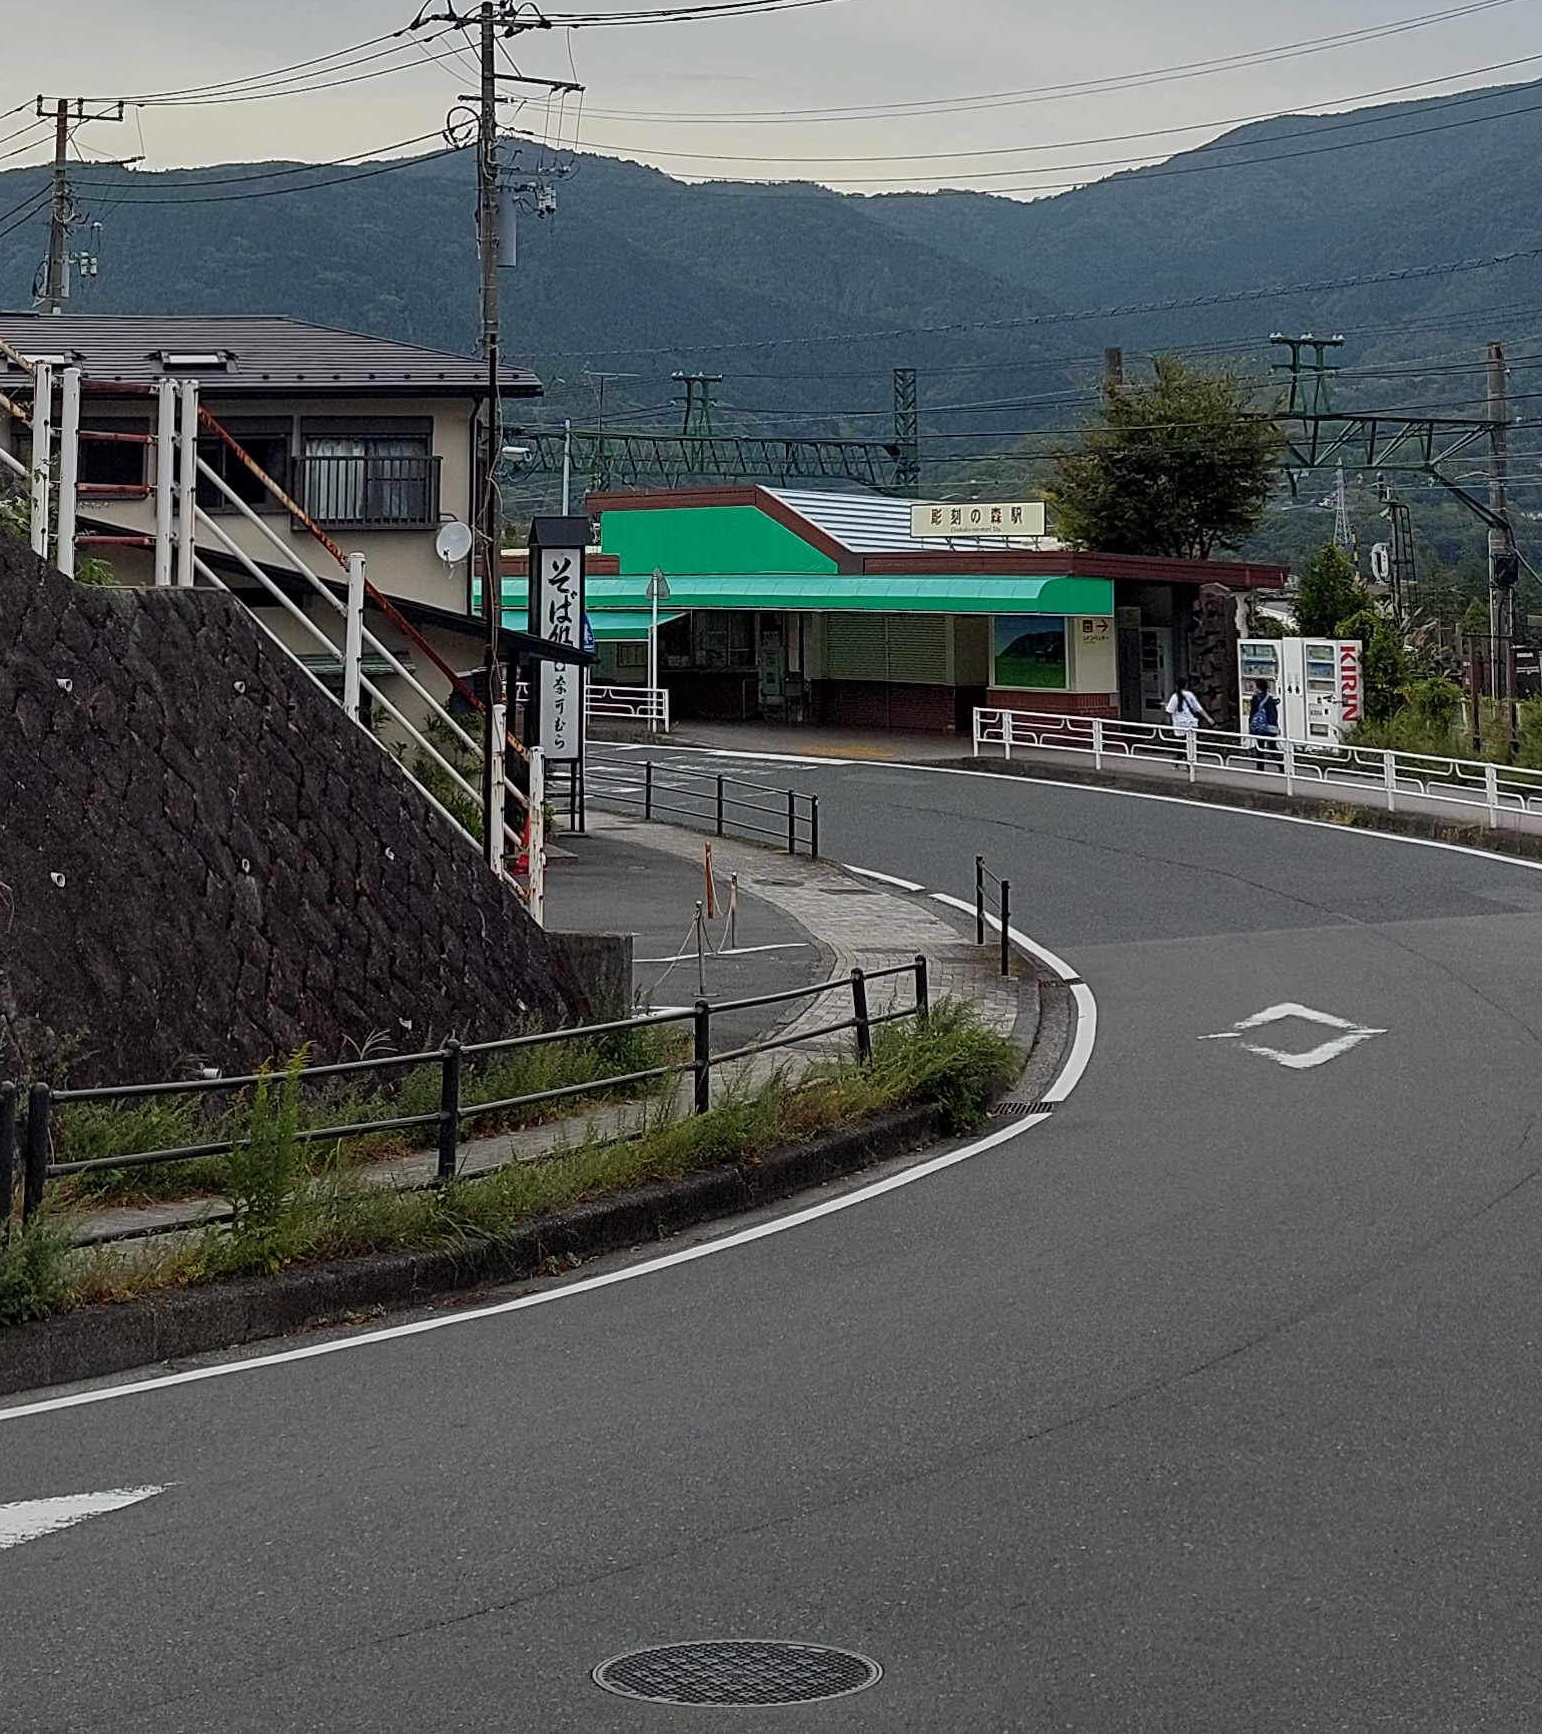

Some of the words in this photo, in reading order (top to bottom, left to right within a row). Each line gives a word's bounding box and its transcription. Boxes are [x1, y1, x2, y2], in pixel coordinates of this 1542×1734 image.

[931, 506, 1023, 526] 彫刻の森駅
[1340, 646, 1359, 722] KIRIN
